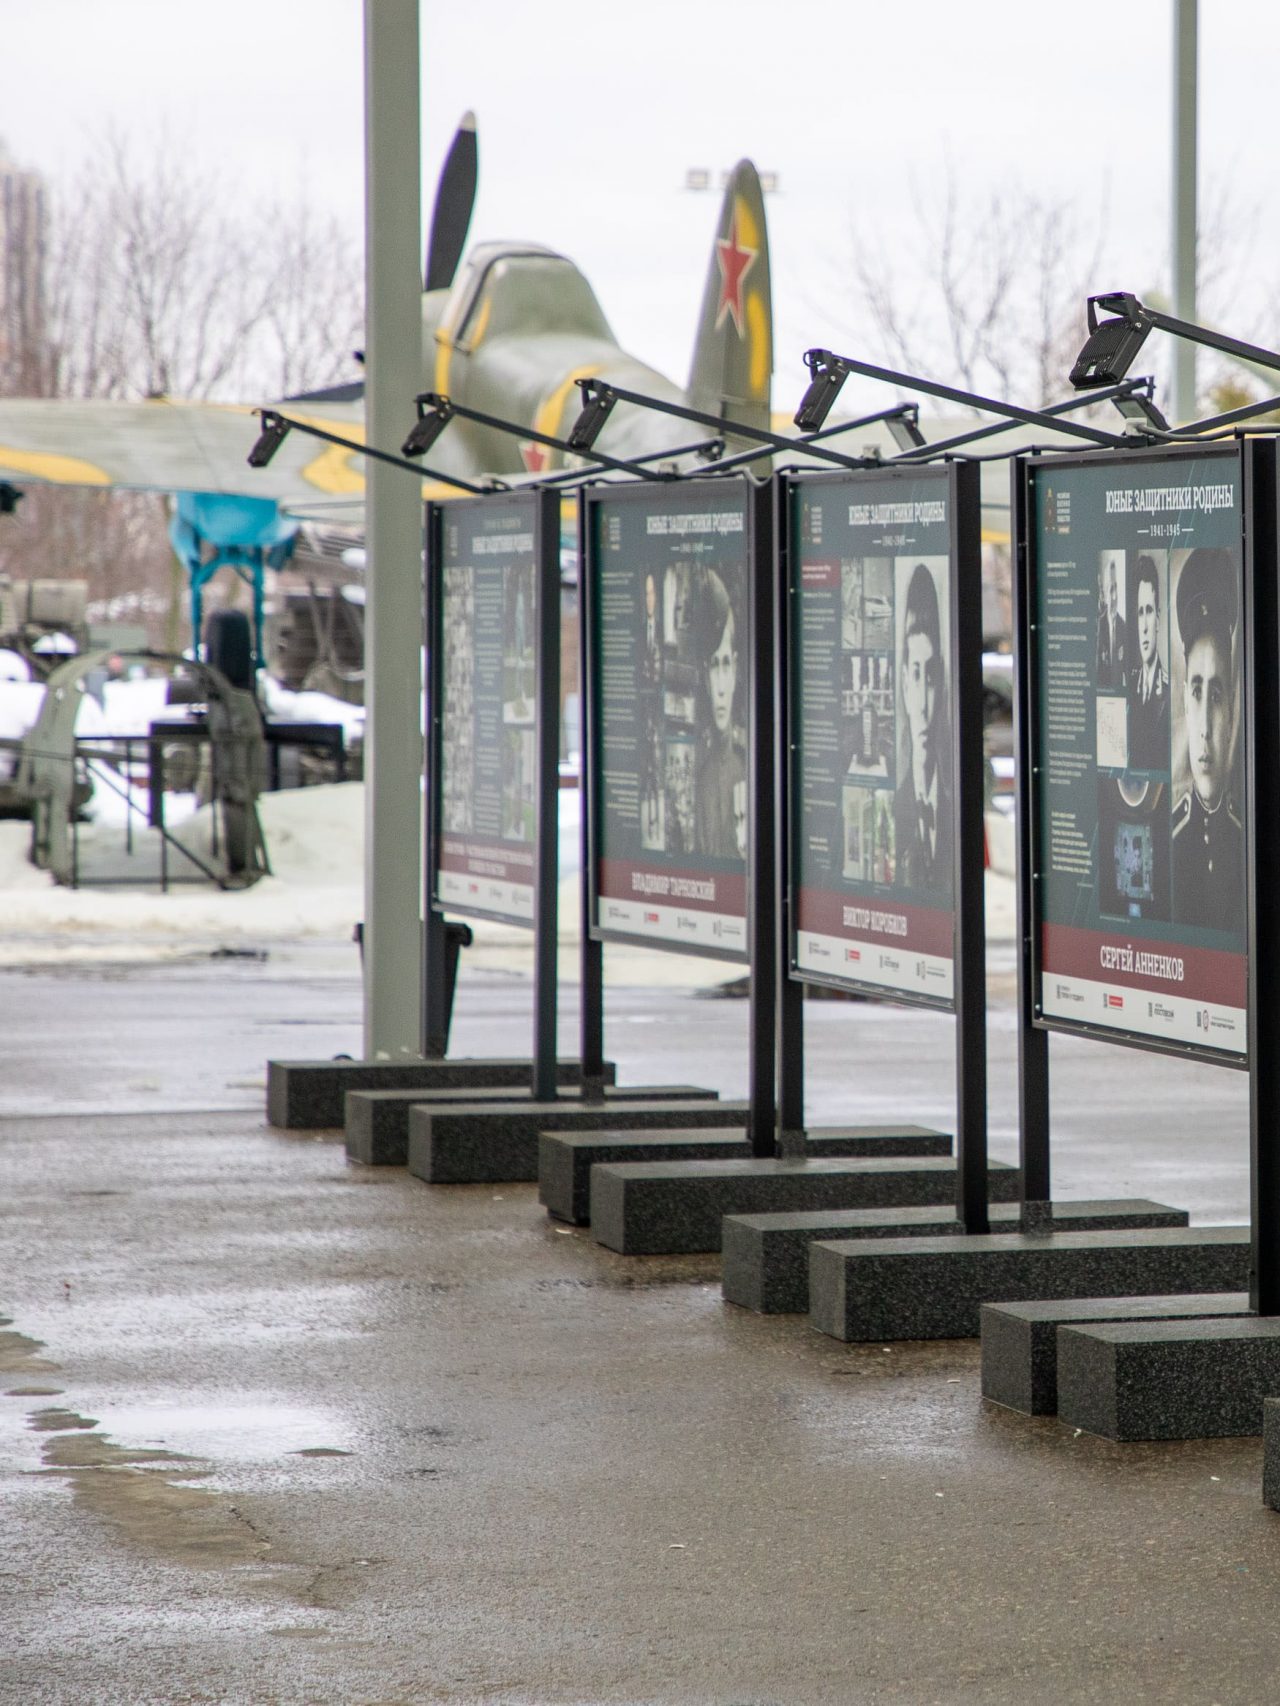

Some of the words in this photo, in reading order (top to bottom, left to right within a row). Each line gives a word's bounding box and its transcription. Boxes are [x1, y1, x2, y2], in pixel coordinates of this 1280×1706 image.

[1105, 490, 1133, 513] ЮНЫЕ
[1134, 486, 1192, 516] ЗАЩИТНИКИ
[1193, 484, 1234, 514] РОДИНЫ
[1100, 944, 1134, 972] СЕРГЕЙ
[1134, 951, 1184, 981] АННЕНКОВ
